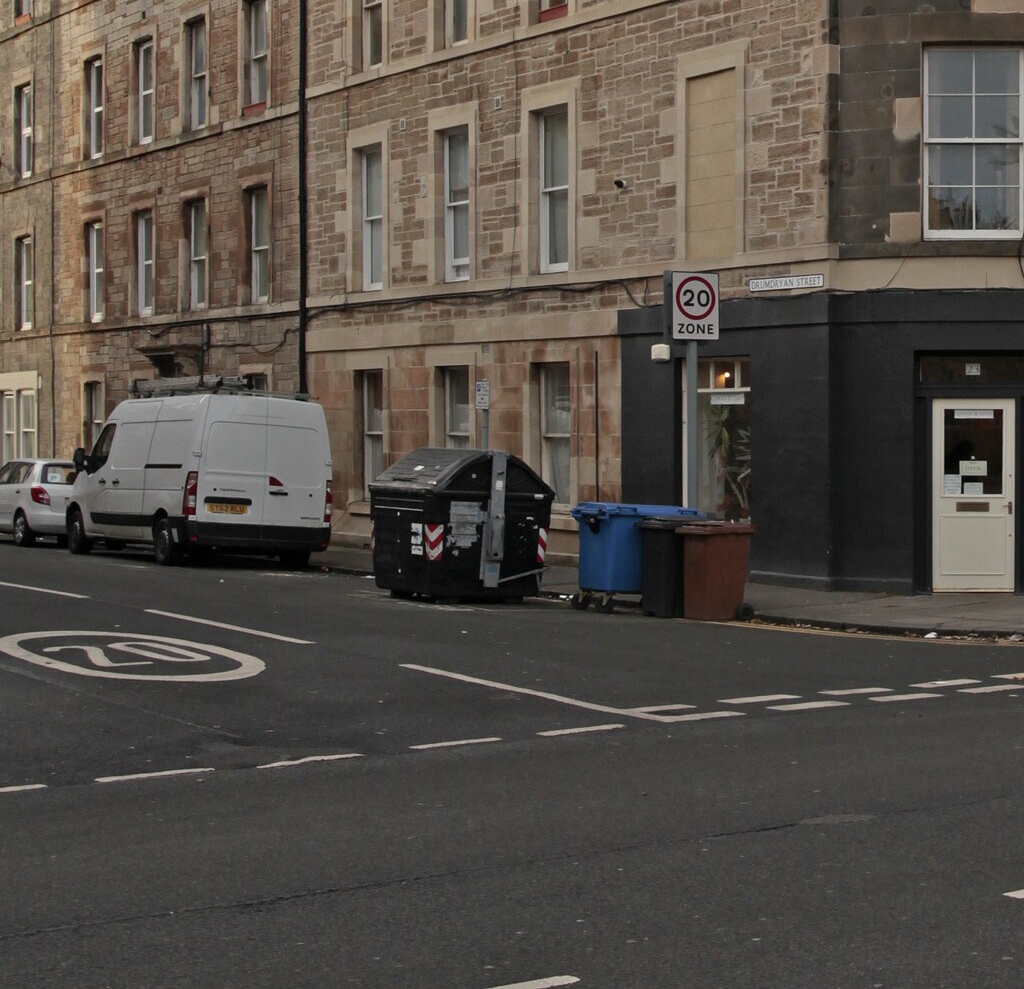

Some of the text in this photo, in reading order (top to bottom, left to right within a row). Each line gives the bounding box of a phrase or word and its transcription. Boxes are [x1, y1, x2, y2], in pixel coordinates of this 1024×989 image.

[751, 276, 822, 290] DRUMDRYAN STREET
[683, 289, 710, 307] 20
[678, 323, 714, 334] ZONE
[967, 363, 980, 374] 23
[230, 505, 245, 513] RLU
[43, 641, 211, 667] 20
